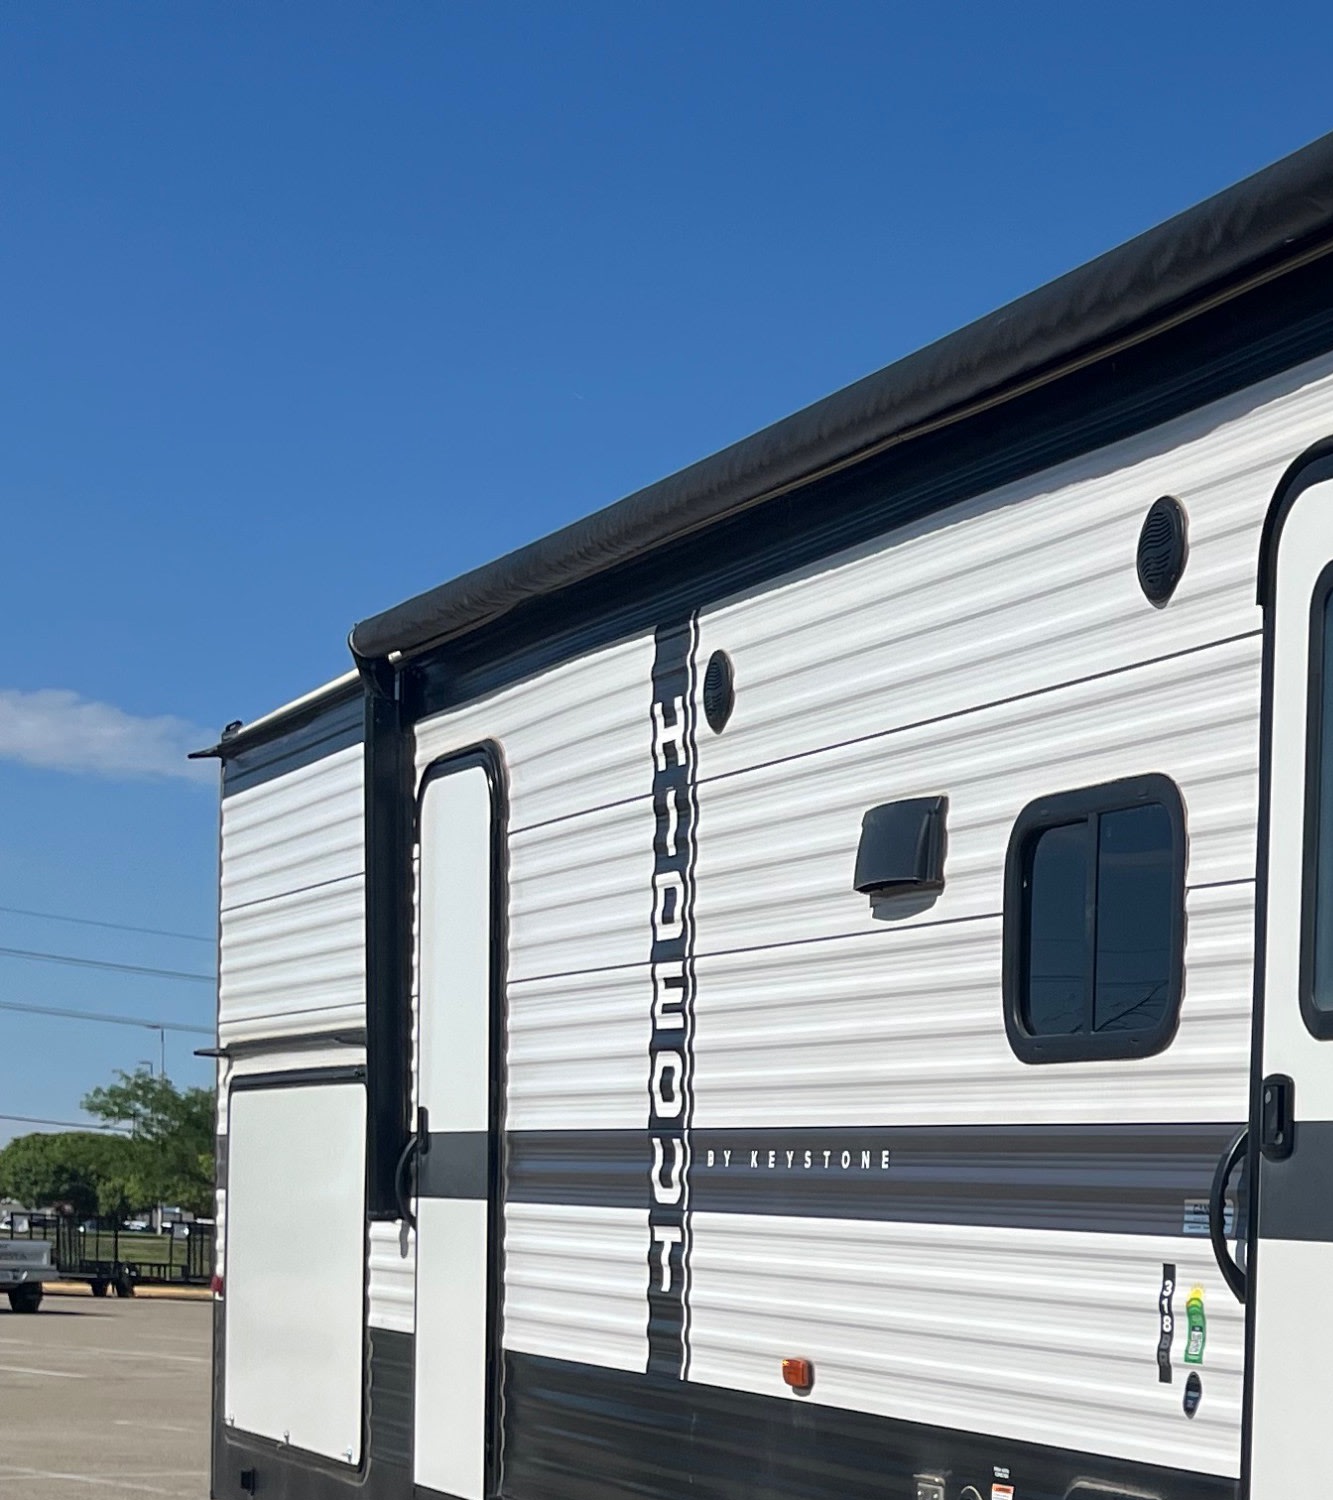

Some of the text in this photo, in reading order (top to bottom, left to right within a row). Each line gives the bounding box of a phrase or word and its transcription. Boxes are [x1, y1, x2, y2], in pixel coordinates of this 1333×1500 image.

[652, 696, 686, 1293] HIDEOUT
[707, 1150, 890, 1169] BY KEYSTONE
